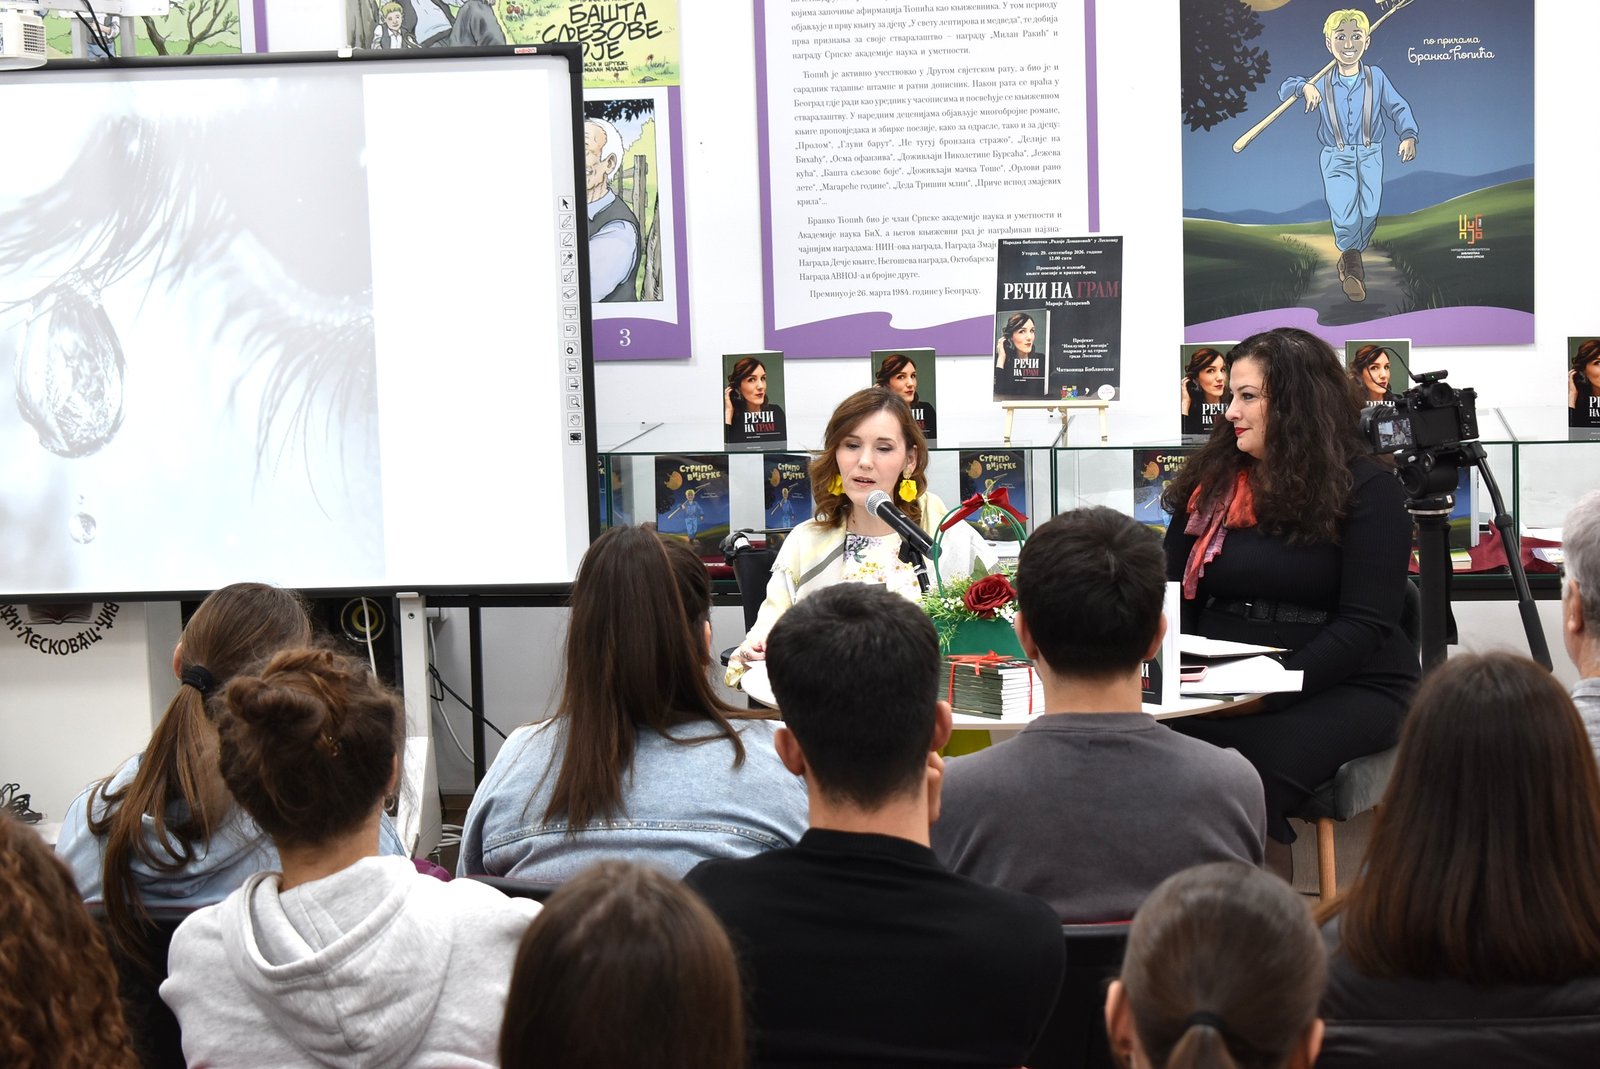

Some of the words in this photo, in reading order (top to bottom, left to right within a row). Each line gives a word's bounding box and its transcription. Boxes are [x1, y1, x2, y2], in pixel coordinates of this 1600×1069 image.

[569, 2, 647, 24] БАШТА
[791, 8, 817, 18] којима
[902, 4, 934, 12] Ћопића
[1025, 2, 1058, 10] периоду
[813, 37, 850, 46] признања
[866, 34, 886, 44] своје
[955, 32, 986, 41] награду
[1437, 36, 1480, 48] причама
[792, 52, 822, 61] награду
[824, 49, 852, 59] Српске
[1408, 47, 1451, 66] Бранка
[1449, 45, 1495, 61] Ћопића
[803, 70, 828, 78] Ћопић
[926, 66, 954, 76] Другом
[792, 86, 828, 94] сарадник
[905, 83, 928, 91] ратни
[972, 79, 996, 87] Након
[1029, 77, 1052, 87] враћа
[793, 98, 825, 108] Београд
[874, 98, 906, 106] уредник
[915, 138, 935, 147] тугуј
[938, 136, 975, 146] бронзана
[914, 180, 946, 190] Тришин
[1027, 177, 1061, 187] змајевих
[808, 216, 835, 226] Бранко
[838, 215, 863, 223] Ћопић
[911, 214, 939, 223] Српске
[982, 214, 1004, 222] наука
[839, 231, 861, 239] наука
[798, 244, 831, 254] чајнијим
[875, 242, 910, 250] НИН-ова
[944, 240, 976, 250] Награда
[798, 259, 830, 268] Награда
[830, 258, 851, 268] Дечје
[877, 256, 917, 264] Његошева
[799, 272, 830, 282] Награда
[871, 271, 896, 280] бројне
[810, 289, 849, 299] Преминуо
[869, 290, 890, 298] марта
[1003, 282, 1047, 300] РЕЧИ
[1051, 281, 1073, 299] НА
[1076, 280, 1119, 298] ГРАМ
[620, 328, 631, 347] 3
[1014, 358, 1039, 369] РЕЧИ
[744, 411, 774, 423] РЕЧИ
[1202, 415, 1213, 424] НА
[745, 424, 755, 432] НА
[755, 423, 775, 432] ГРАМ
[17, 625, 102, 655] ЛЕСКОВАЦ
